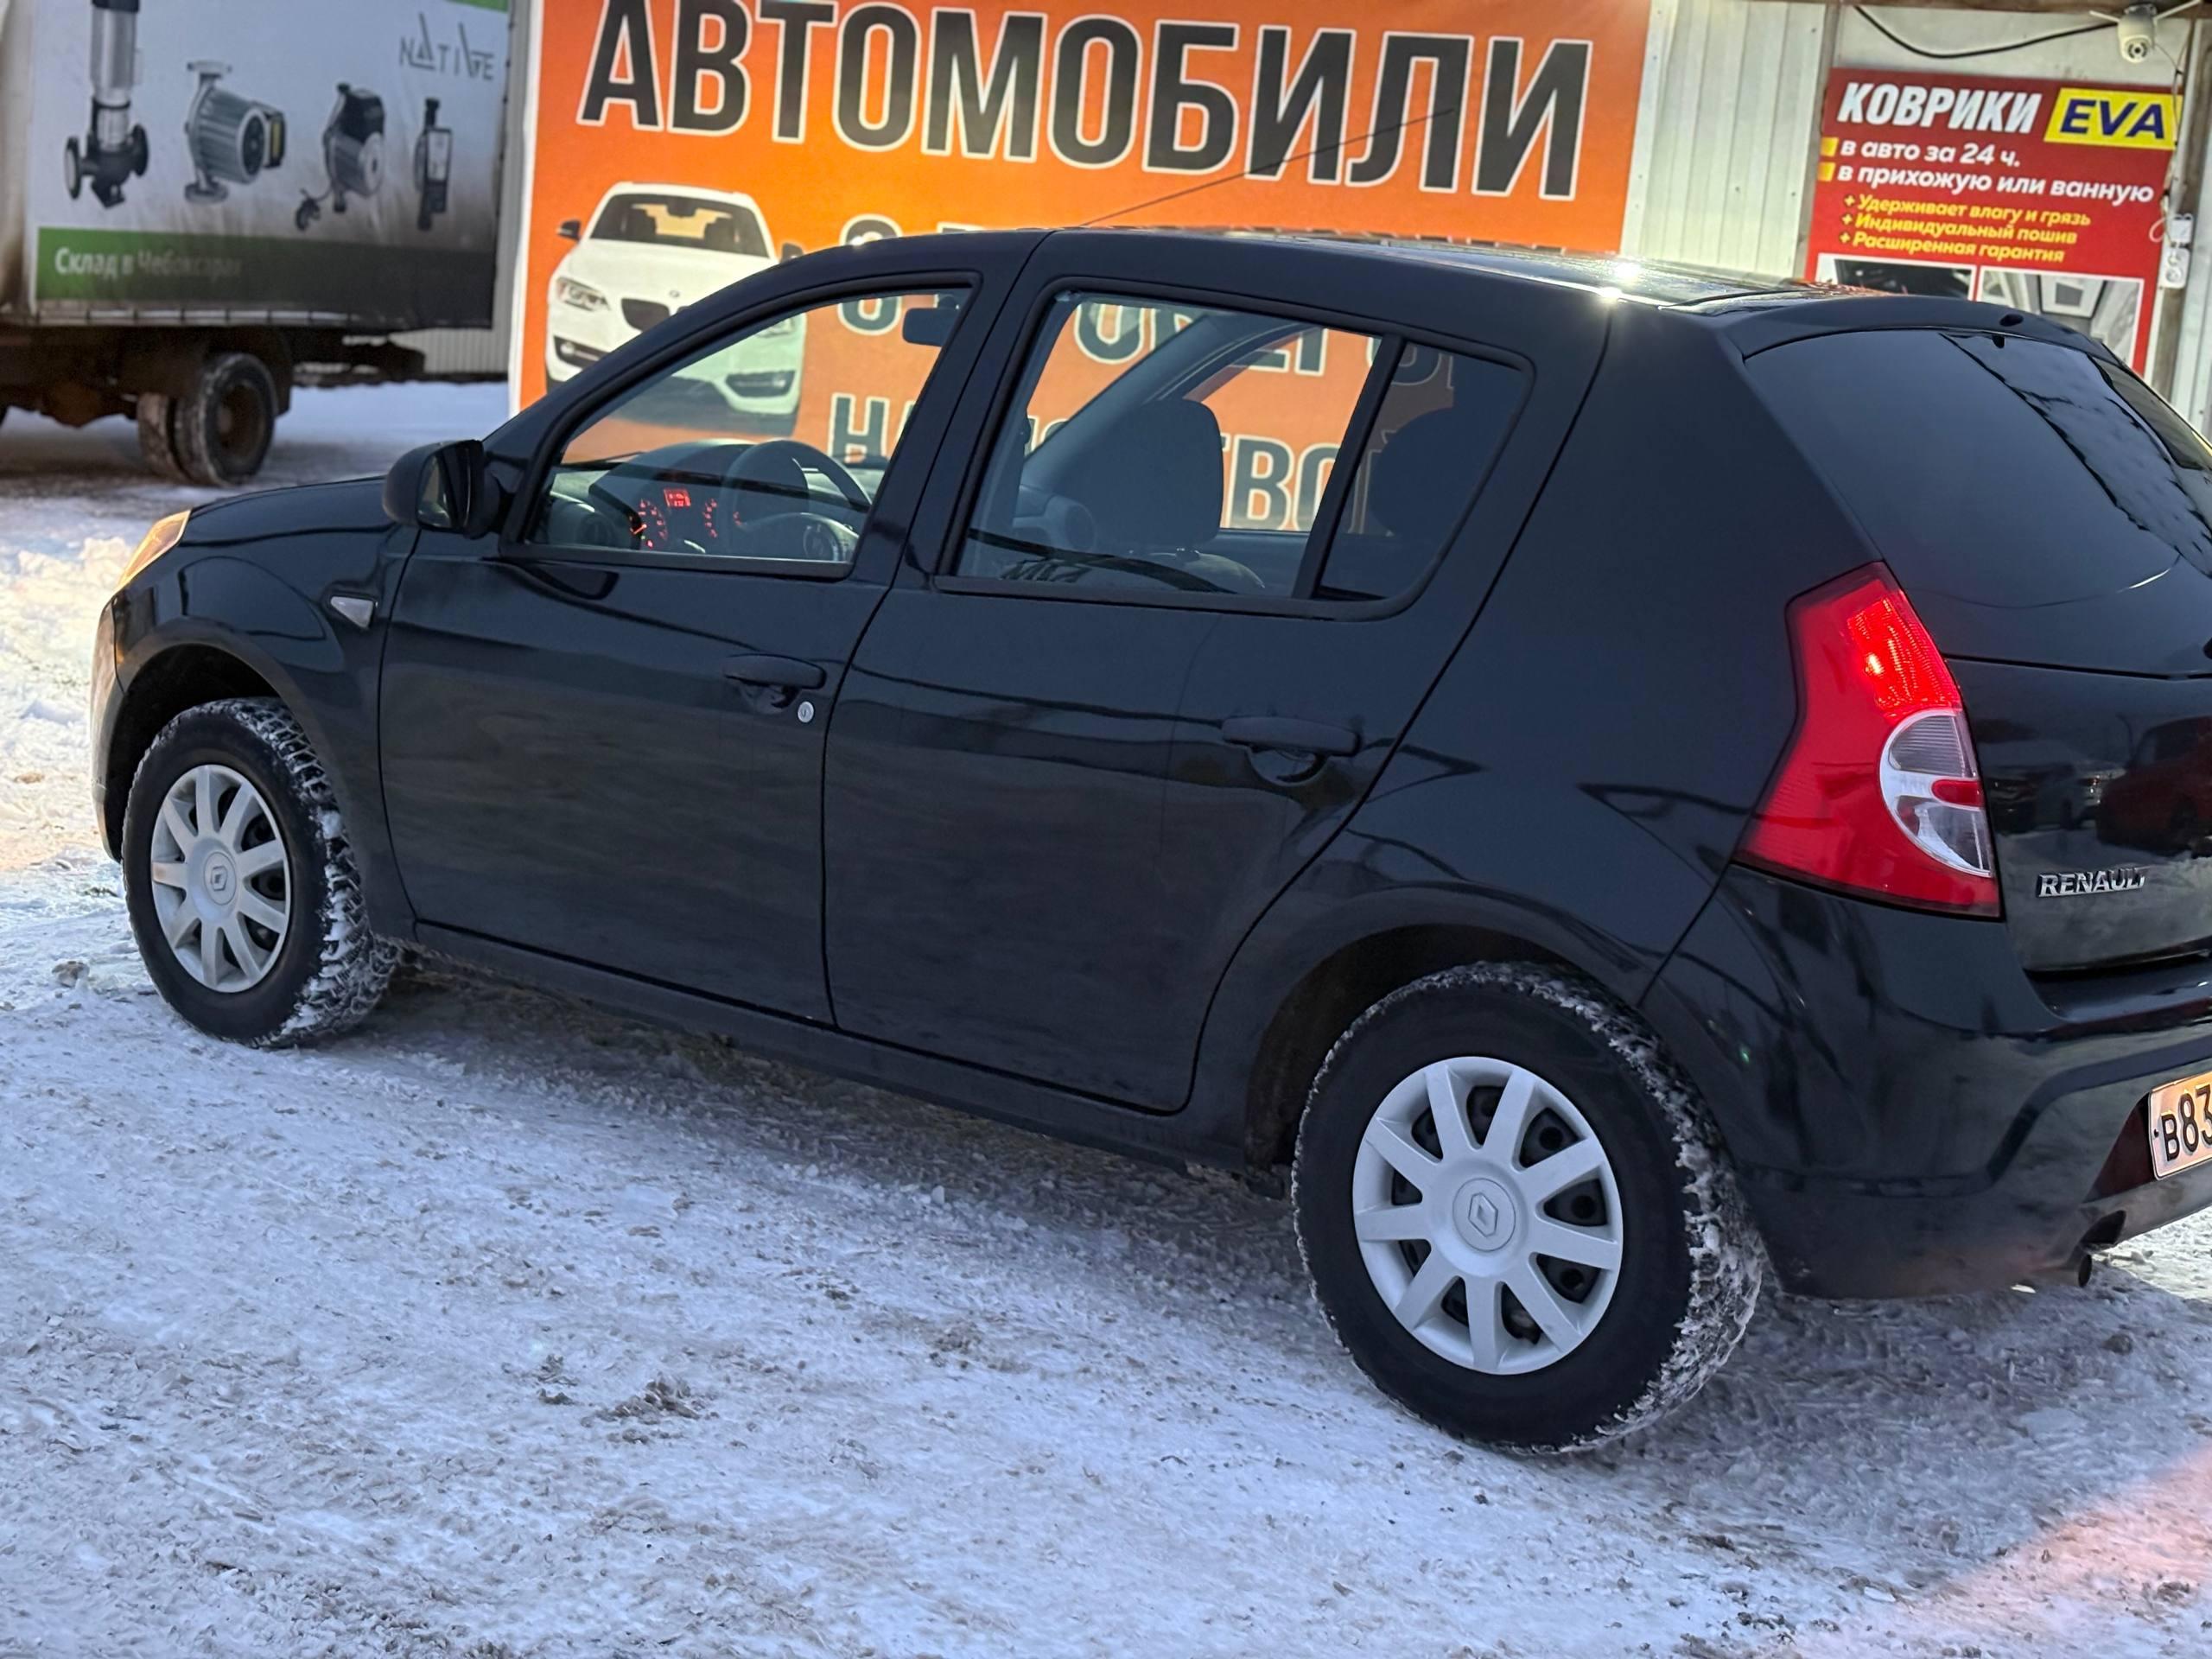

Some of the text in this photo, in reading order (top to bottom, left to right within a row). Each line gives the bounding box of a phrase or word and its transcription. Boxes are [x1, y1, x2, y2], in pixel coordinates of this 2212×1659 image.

[576, 0, 1592, 200] АВТОМОБИЛИ
[1837, 82, 2165, 140] КОВРИКИ EVA
[1840, 140, 2020, 167] в авто за 24 ч.
[1837, 165, 2155, 207] в прихожую или ванную
[1857, 194, 2091, 227] Удерживает влагу и грязь
[1855, 213, 2078, 245] Индивидуальный пошив
[54, 246, 118, 281] Склад
[1852, 231, 2065, 263] Расширенная гарантия
[2037, 866, 2148, 898] RENAULT
